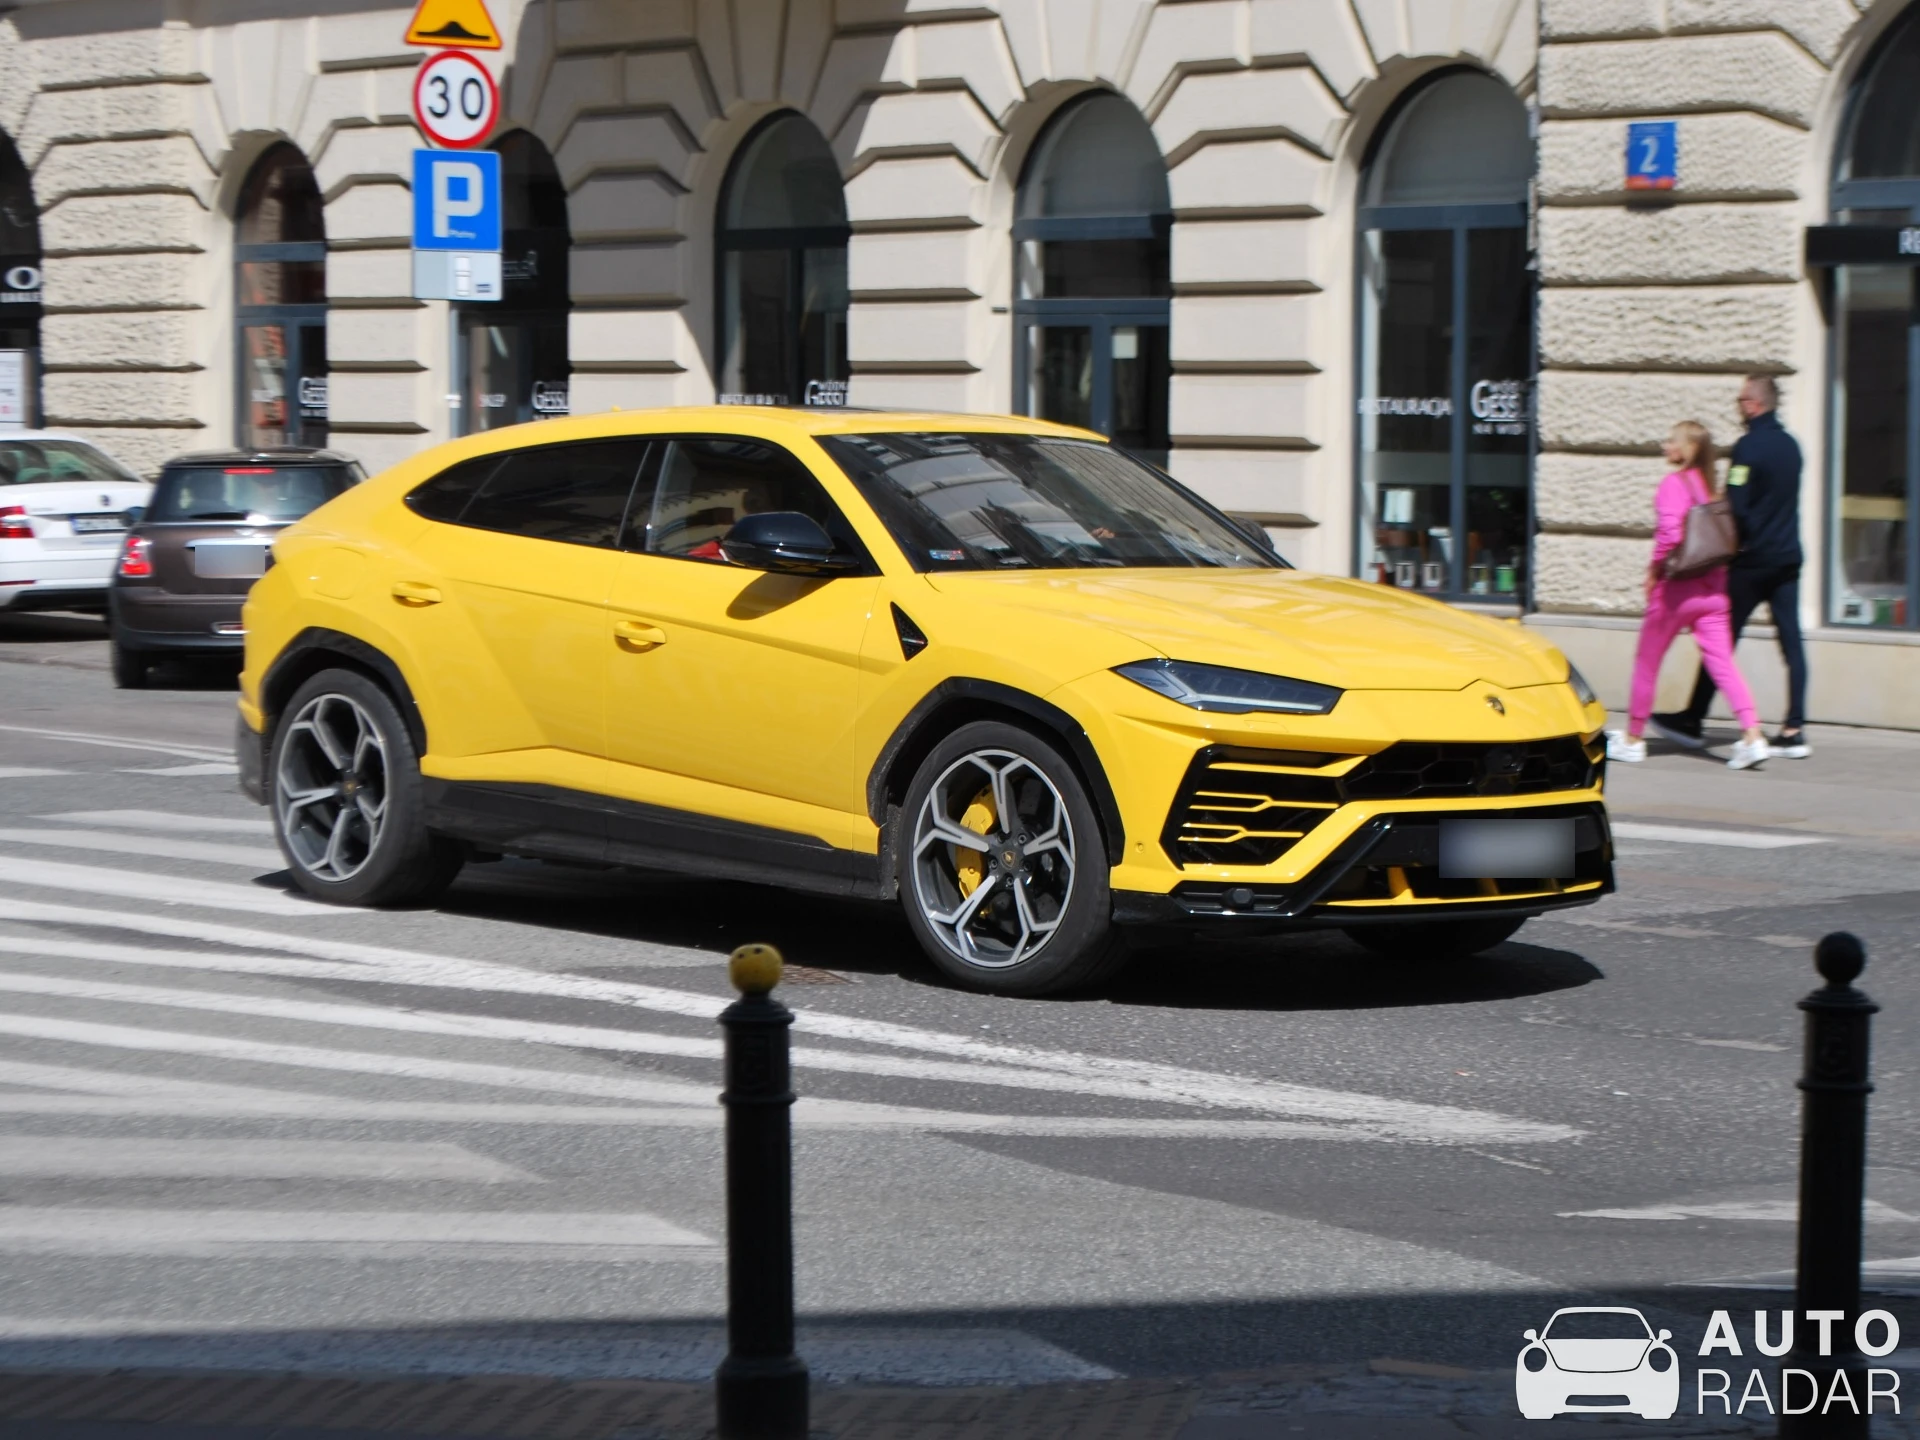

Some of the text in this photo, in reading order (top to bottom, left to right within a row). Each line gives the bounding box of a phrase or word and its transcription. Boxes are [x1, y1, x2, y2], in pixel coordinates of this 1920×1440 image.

[427, 75, 484, 120] 30
[1639, 136, 1661, 173] 2
[432, 161, 484, 238] P
